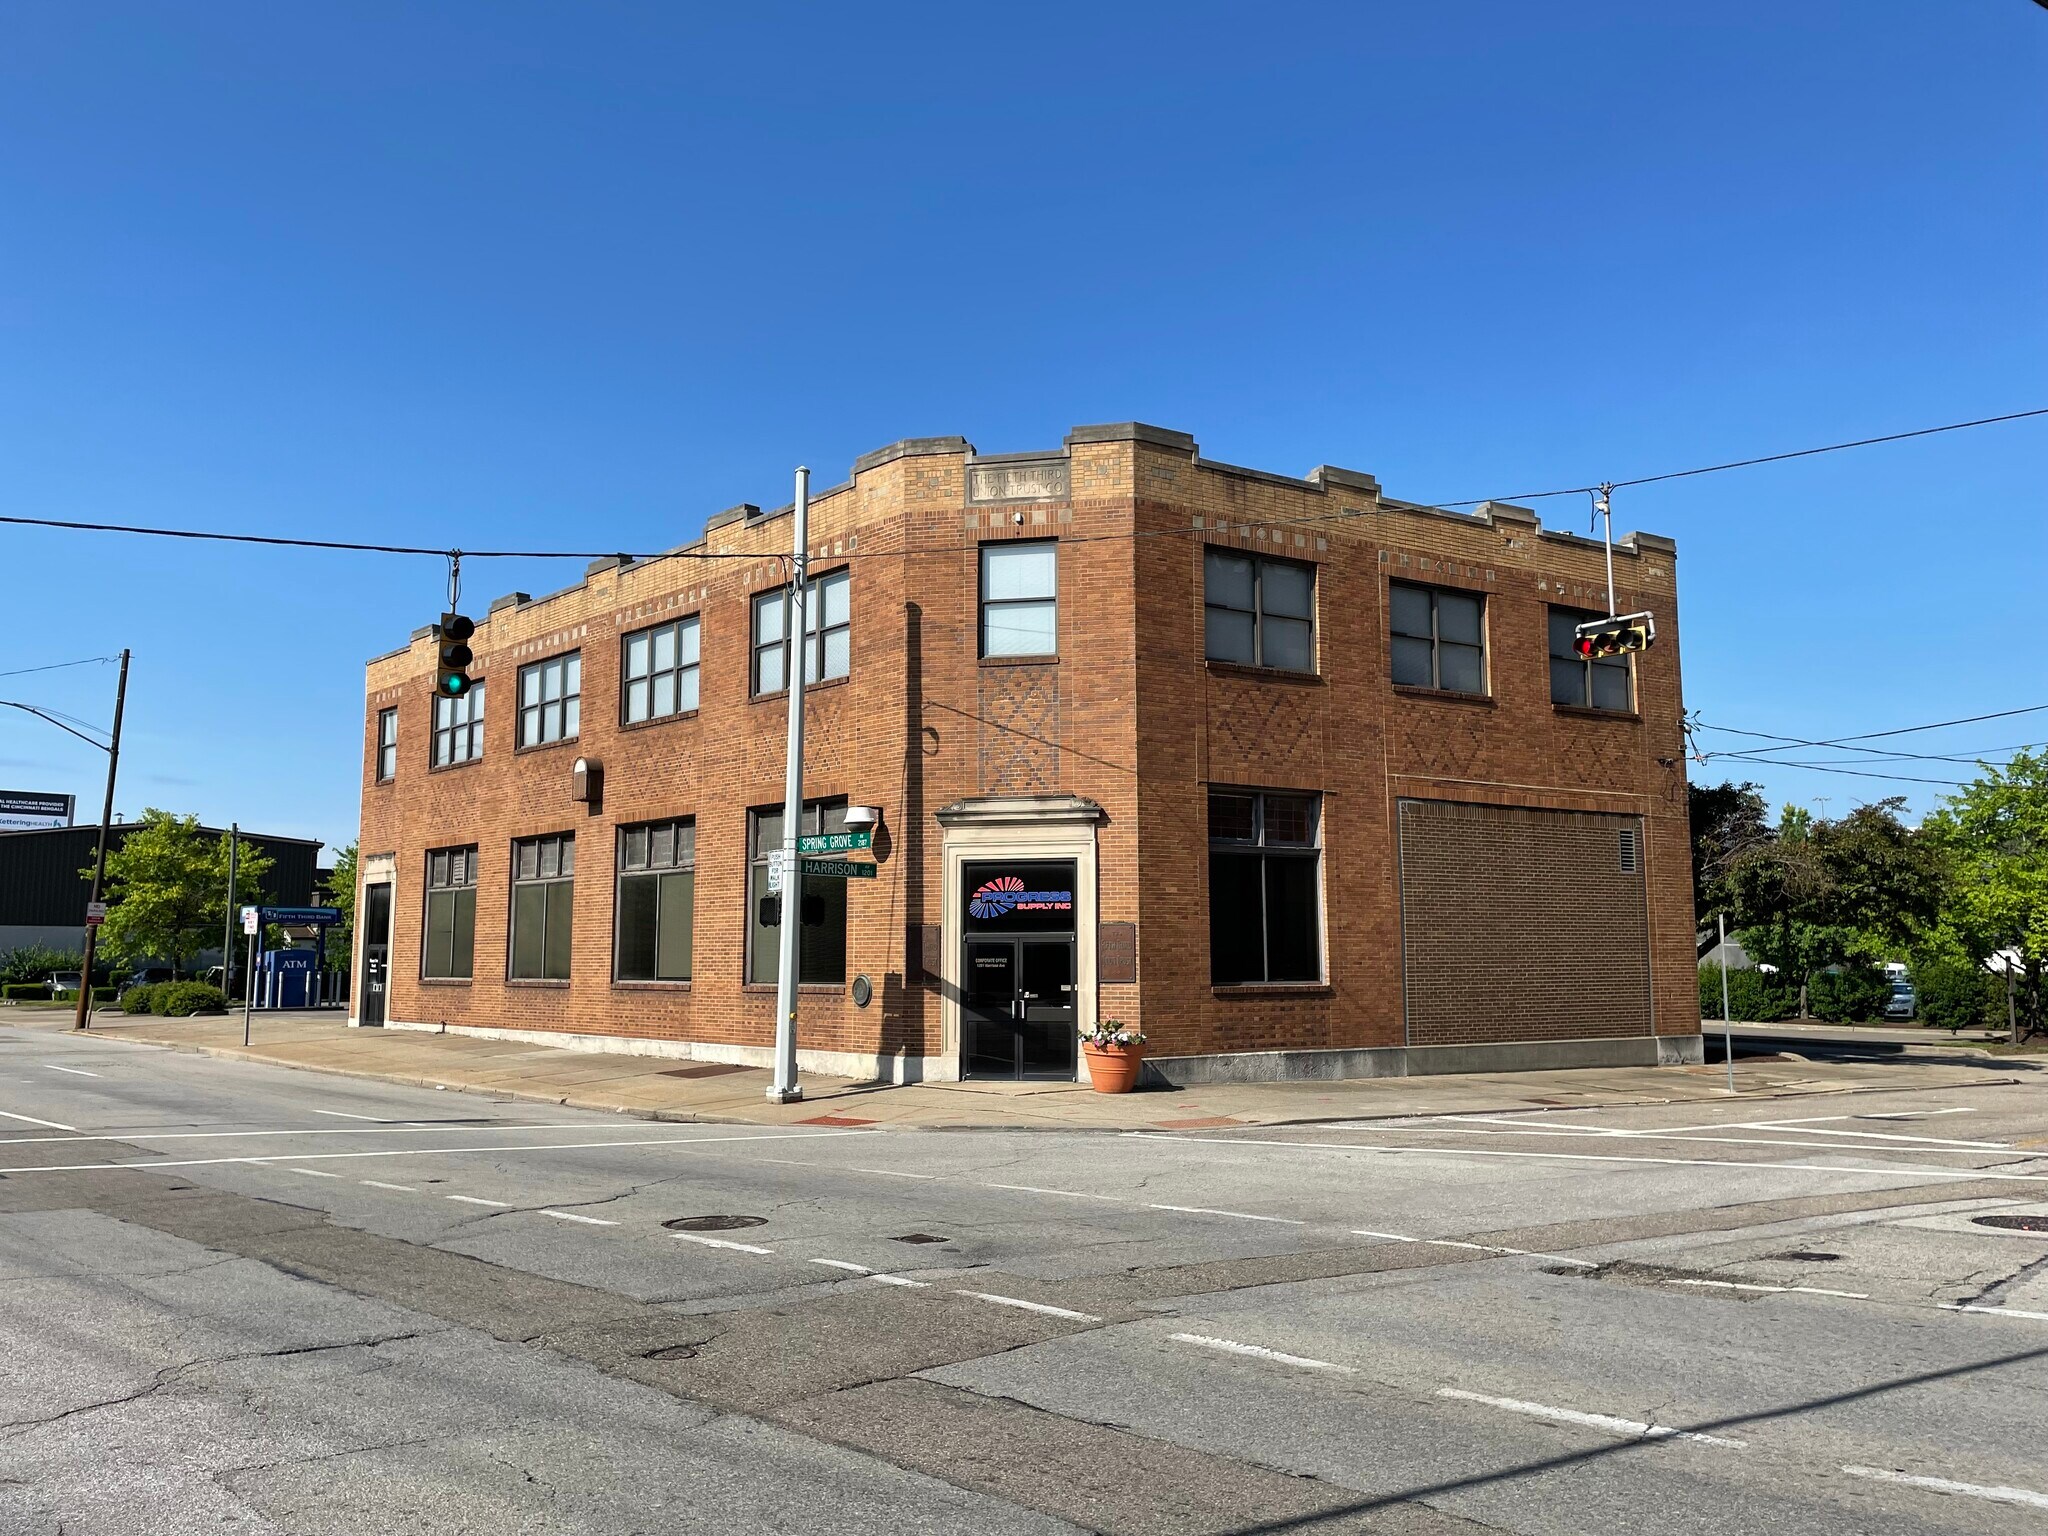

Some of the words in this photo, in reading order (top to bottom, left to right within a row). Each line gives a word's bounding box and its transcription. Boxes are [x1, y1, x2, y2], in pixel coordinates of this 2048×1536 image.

[974, 473, 994, 484] THE
[997, 471, 1027, 483] FIFTH
[1031, 469, 1062, 481] THIRD
[973, 485, 1006, 498] UNION
[1010, 483, 1042, 495] TRUST
[1045, 481, 1062, 493] CO
[802, 836, 827, 850] SPRING
[829, 835, 853, 848] GROVE
[805, 861, 858, 875] HARRISON
[981, 891, 1072, 902] PROGRESS
[282, 960, 307, 969] ATM
